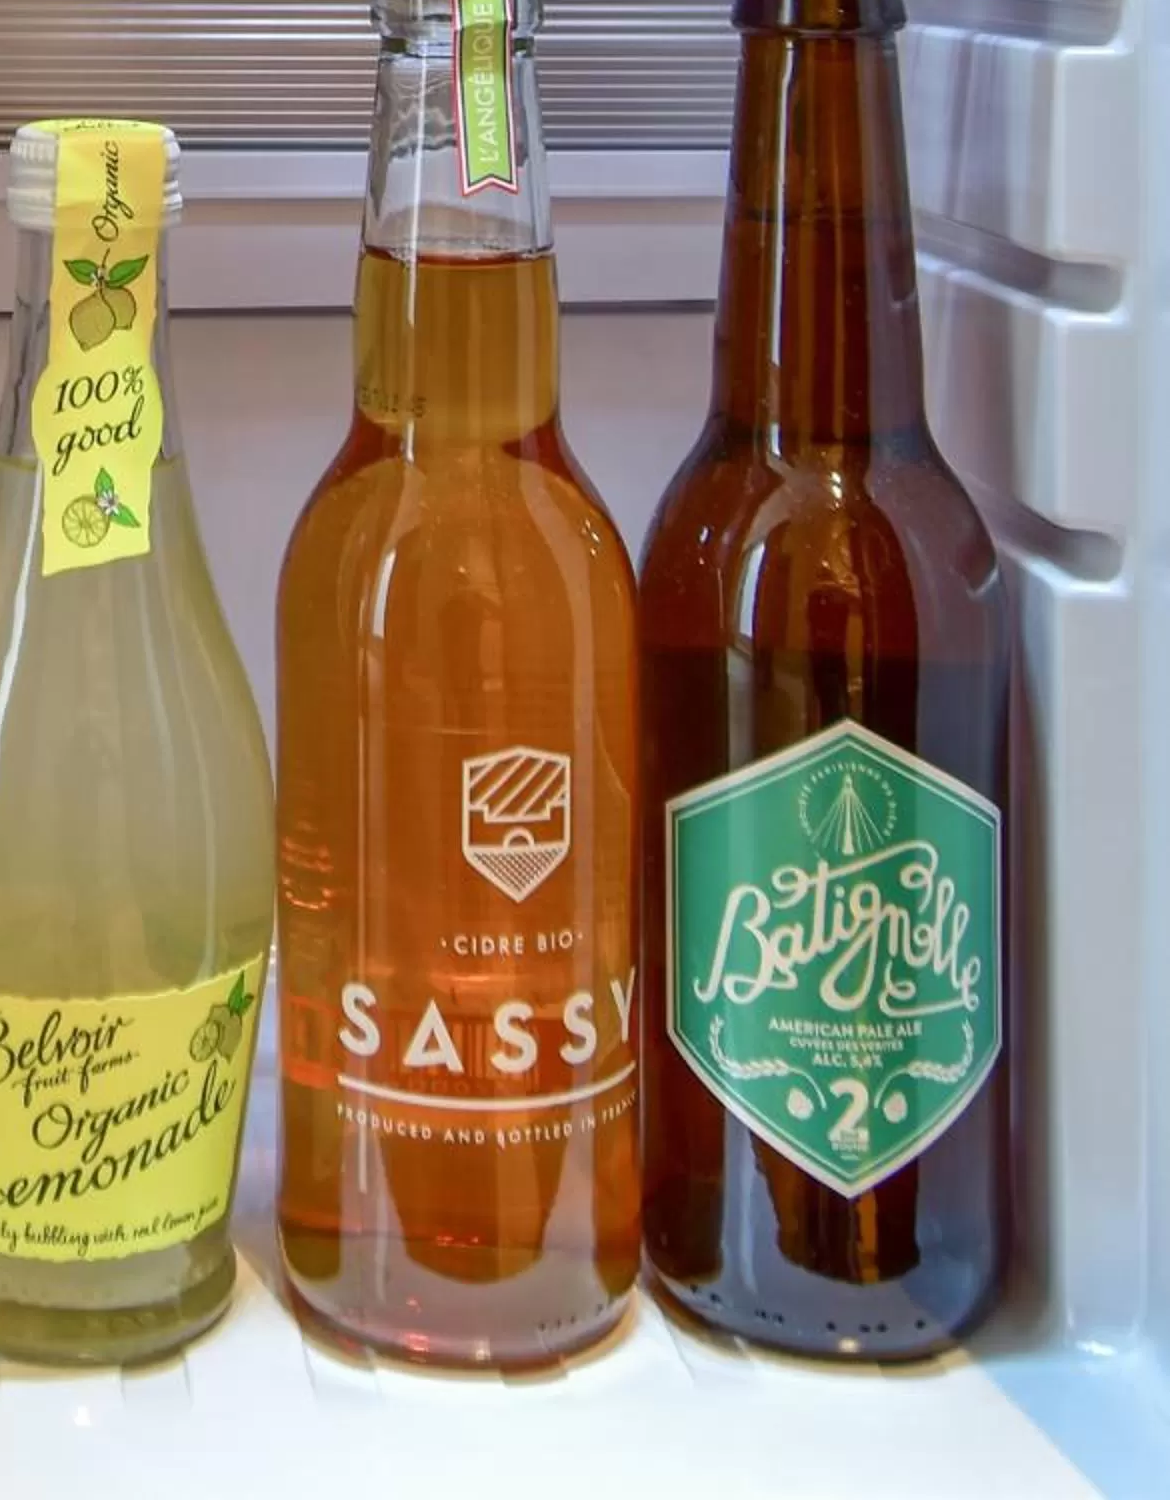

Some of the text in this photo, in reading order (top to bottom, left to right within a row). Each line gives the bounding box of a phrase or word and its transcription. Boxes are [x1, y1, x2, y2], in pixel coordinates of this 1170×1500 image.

[469, 2, 500, 162] L'ANGÉLIQUE
[91, 140, 134, 242] Organic
[53, 366, 144, 416] 100%
[52, 395, 145, 476] good
[452, 930, 574, 957] CIDRE BIO
[692, 838, 981, 1018] Batignolle
[338, 964, 638, 1076] SASSY
[768, 1017, 923, 1039] AMERICAN PALE ALE
[11, 1050, 141, 1109] fruit farms
[31, 1067, 191, 1164] Organic
[827, 1076, 870, 1145] 2
[336, 1101, 432, 1141] PRODUCED
[443, 1128, 486, 1146] AND
[496, 1121, 573, 1148] BOTTLED
[580, 1113, 596, 1132] IN
